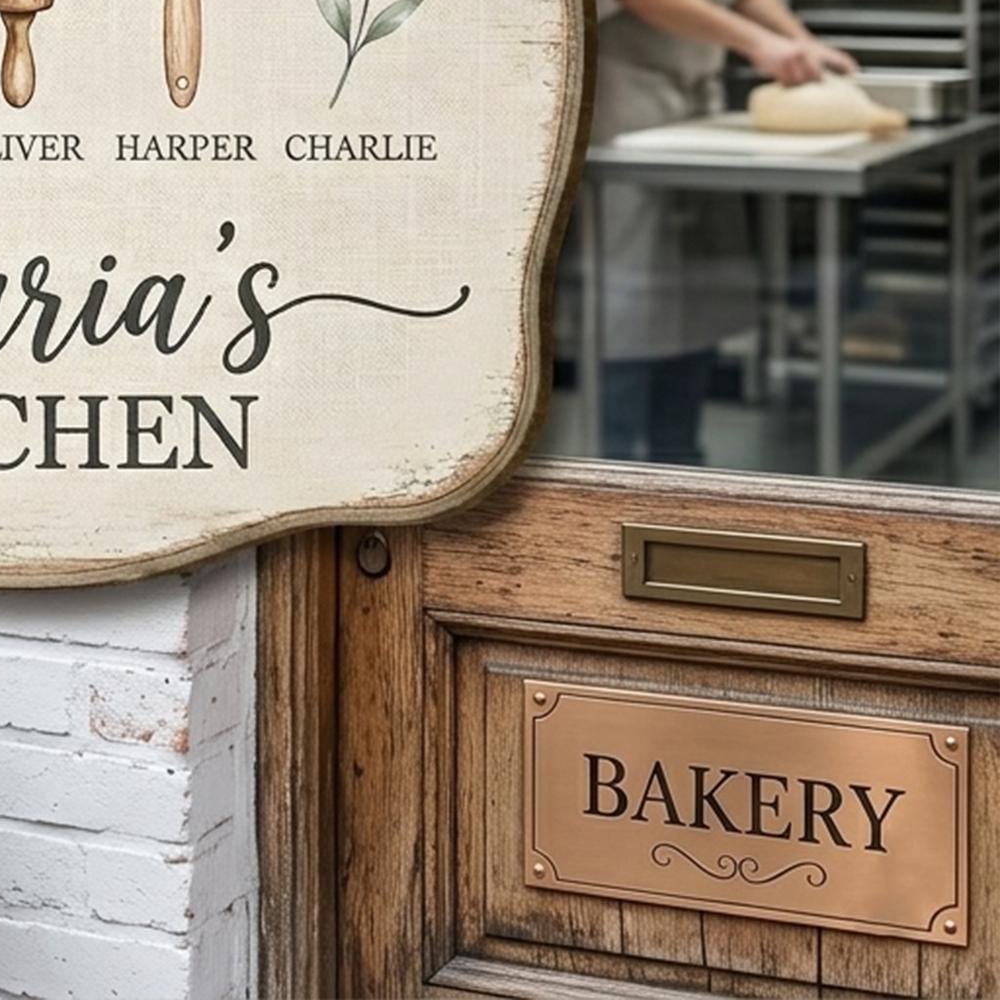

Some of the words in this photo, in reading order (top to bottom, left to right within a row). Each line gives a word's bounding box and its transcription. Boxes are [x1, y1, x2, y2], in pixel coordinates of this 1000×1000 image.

[115, 134, 257, 162] HARPER
[285, 134, 438, 162] CHARLIE
[582, 752, 906, 853] BAKERY
